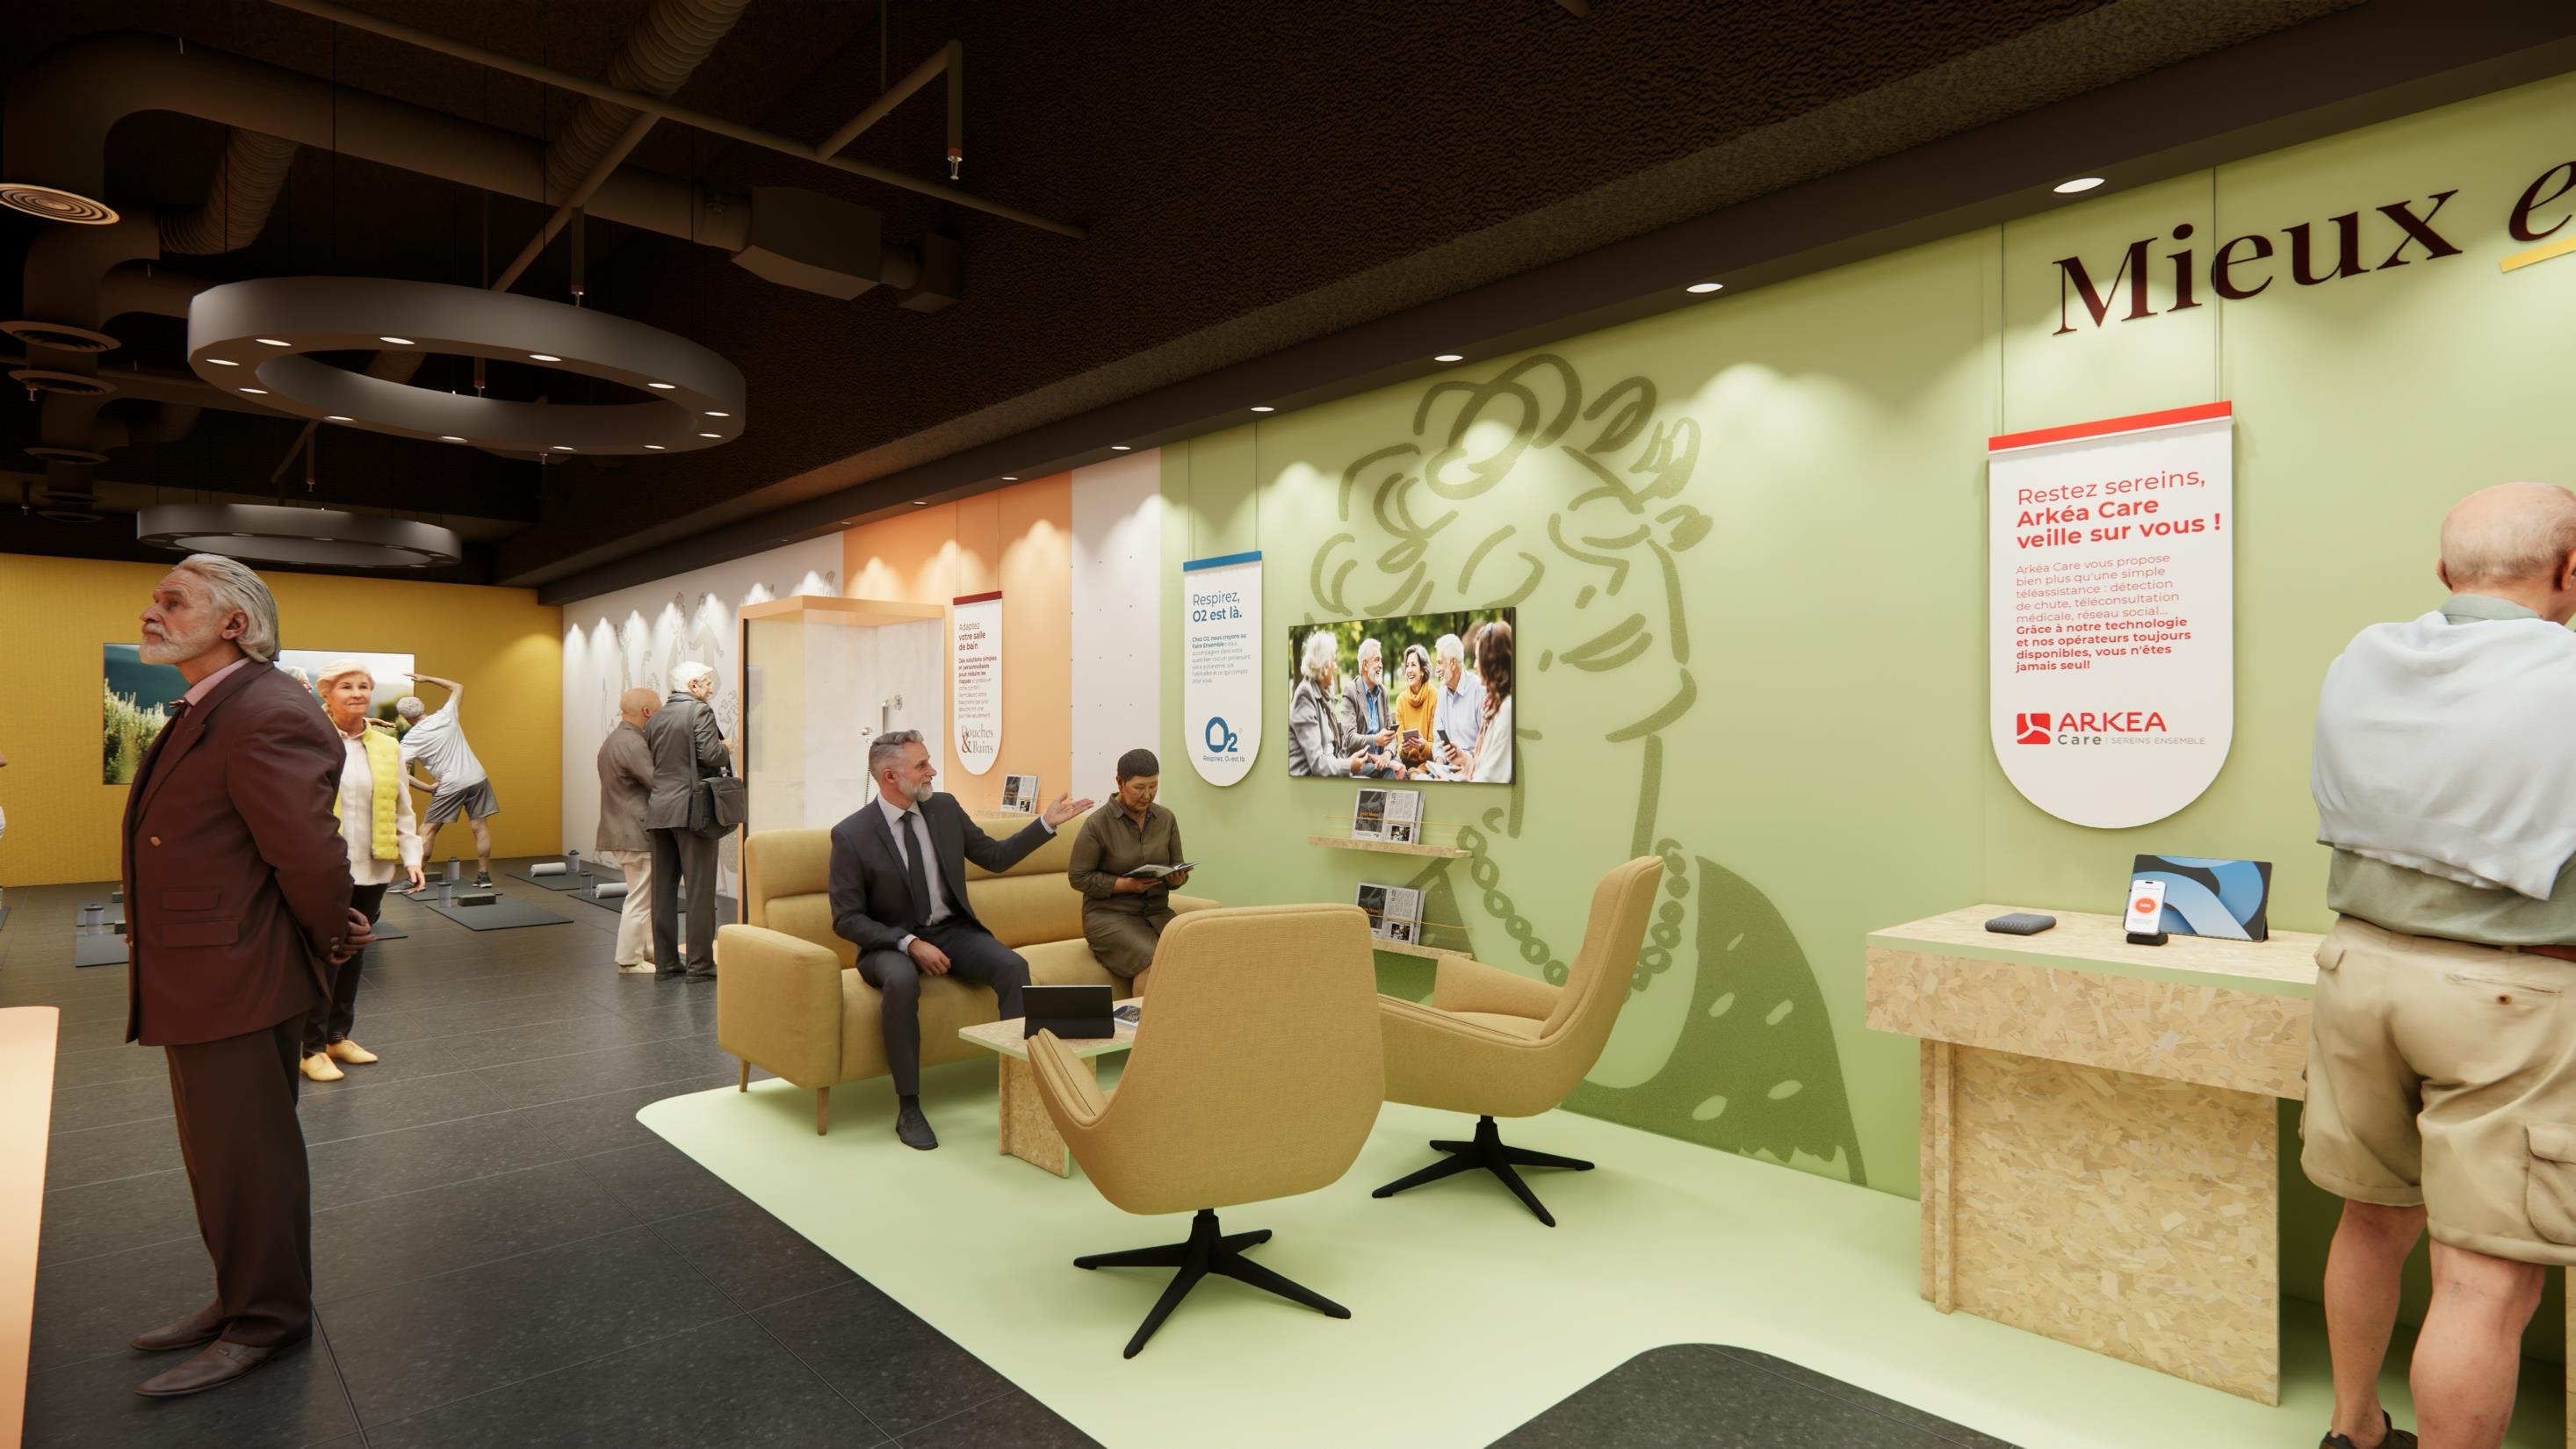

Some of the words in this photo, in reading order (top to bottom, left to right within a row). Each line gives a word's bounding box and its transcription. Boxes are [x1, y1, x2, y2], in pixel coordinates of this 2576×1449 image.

[2053, 189, 2464, 335] Mieux
[2018, 484, 2098, 505] Restez
[2104, 470, 2205, 495] sereins,
[2017, 504, 2089, 527] Arkéa
[2098, 500, 2160, 518] Care
[2017, 528, 2082, 549] veille
[2090, 525, 2131, 542] sur
[2139, 517, 2205, 537] vous
[2017, 564, 2050, 573] Arkéa
[2053, 562, 2081, 572] Care
[2084, 559, 2114, 569] vous
[2117, 555, 2171, 568] propose
[2017, 577, 2042, 587] bien
[2046, 573, 2072, 586] plus
[2074, 572, 2118, 583] qu'une
[2121, 566, 2166, 580] simple
[2017, 585, 2101, 599] téléassistance
[2110, 580, 2174, 592] détection
[1193, 590, 1240, 608] Respirez,
[2017, 602, 2031, 611] de
[2034, 600, 2072, 610] chute,
[2075, 592, 2180, 607] téléconsultation
[1192, 609, 1208, 623] O2
[1209, 608, 1226, 621] est
[1230, 605, 1243, 619] là.
[2017, 612, 2074, 624] médicale,
[2077, 609, 2118, 620] réseau
[2122, 606, 2168, 617] social...
[2017, 625, 2052, 635] Grâce
[2055, 624, 2063, 633] à
[2067, 623, 2102, 632] notre
[2104, 616, 2188, 631] technologie
[966, 641, 978, 651] bain
[2017, 638, 2029, 646] et
[2032, 638, 2054, 646] nos
[2058, 634, 2130, 646] opérateurs
[2132, 631, 2191, 643] toujours
[2017, 648, 2092, 660] disponibles,
[2095, 647, 2126, 656] vous
[2130, 645, 2172, 655] n'êtes
[2016, 660, 2057, 674] jamais
[2060, 660, 2091, 670] seul!
[2058, 712, 2168, 732] ARKEA
[973, 740, 993, 753] Bains
[2058, 734, 2102, 745] Care
